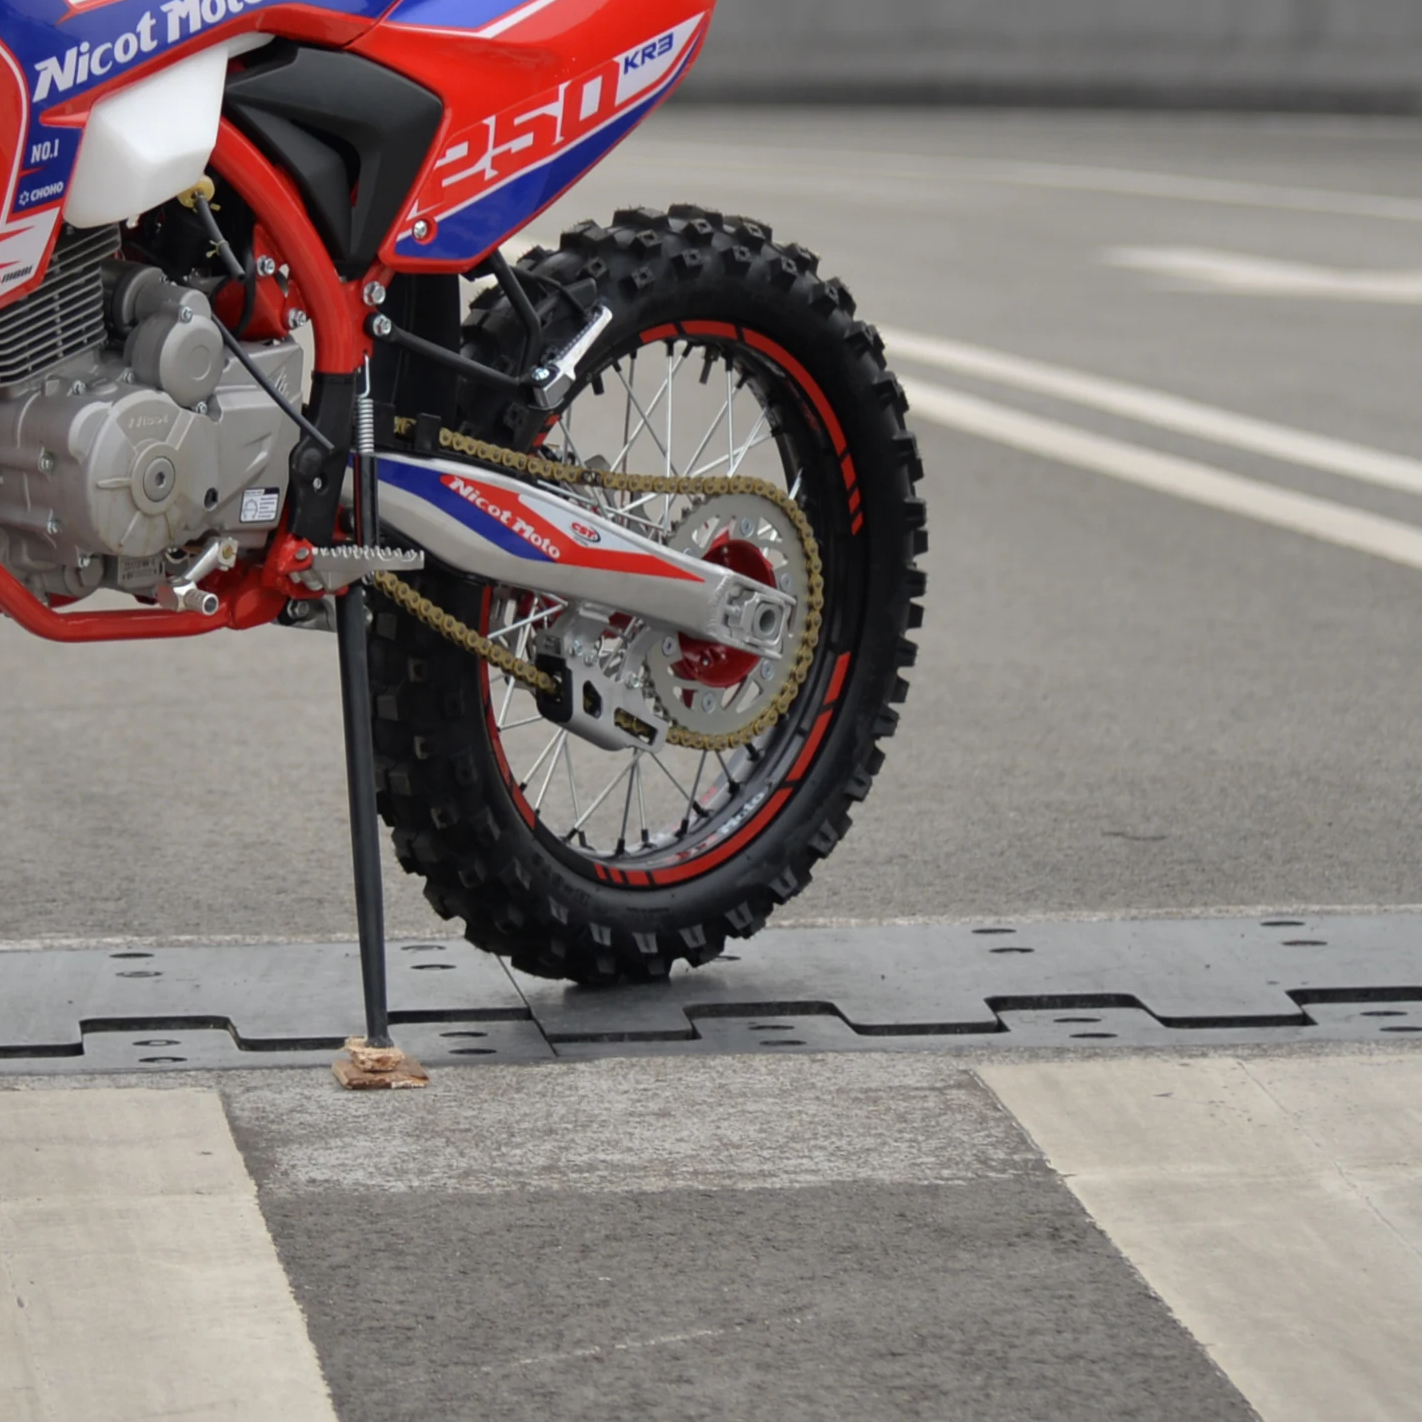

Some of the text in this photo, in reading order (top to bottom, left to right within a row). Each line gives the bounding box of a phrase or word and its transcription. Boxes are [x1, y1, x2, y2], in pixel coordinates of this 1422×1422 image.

[32, 10, 158, 103] Nicot
[623, 32, 674, 75] KR3
[30, 181, 64, 202] CHOHO
[449, 476, 561, 559] Nicot Moto
